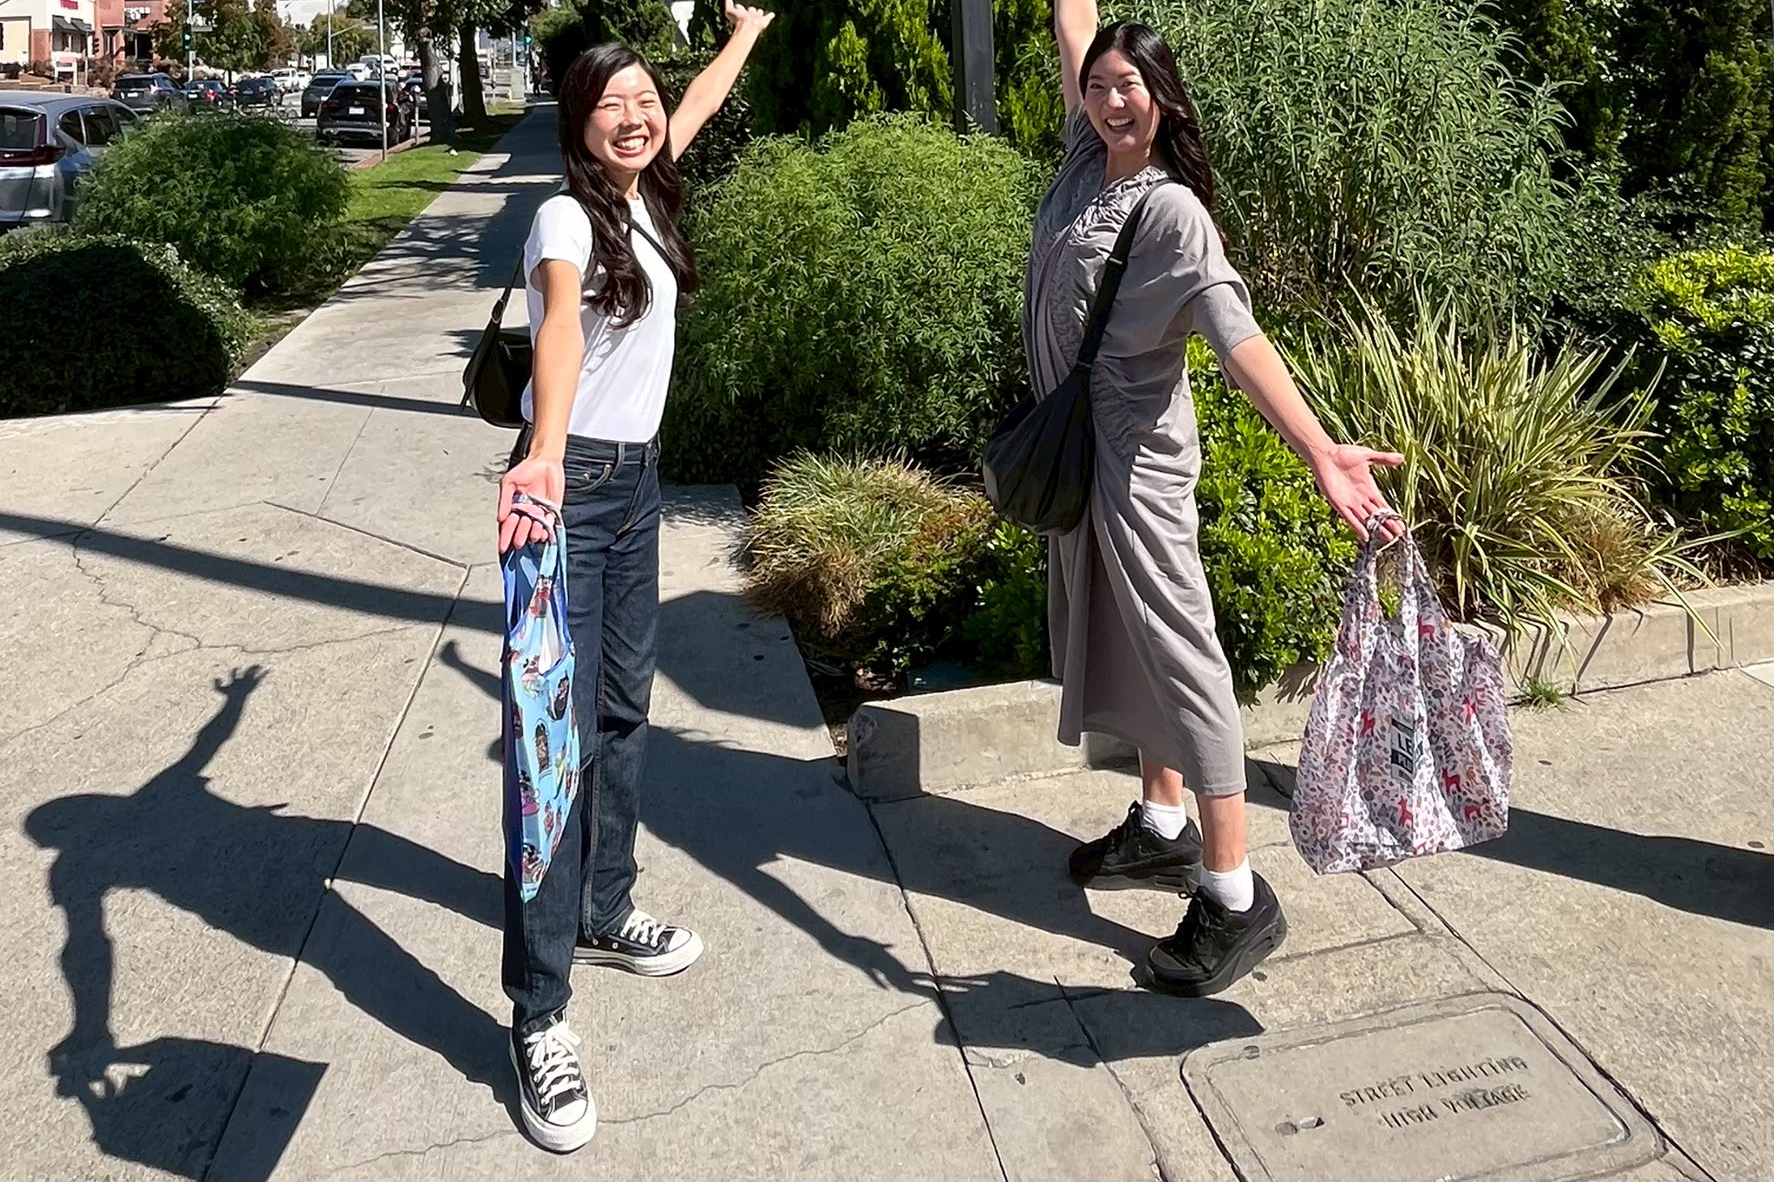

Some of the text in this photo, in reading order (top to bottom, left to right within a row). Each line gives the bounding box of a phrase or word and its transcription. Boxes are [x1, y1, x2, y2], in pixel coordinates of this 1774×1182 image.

[1339, 1056, 1528, 1107] STREET LIGHTING
[1378, 1104, 1439, 1129] HIGH
